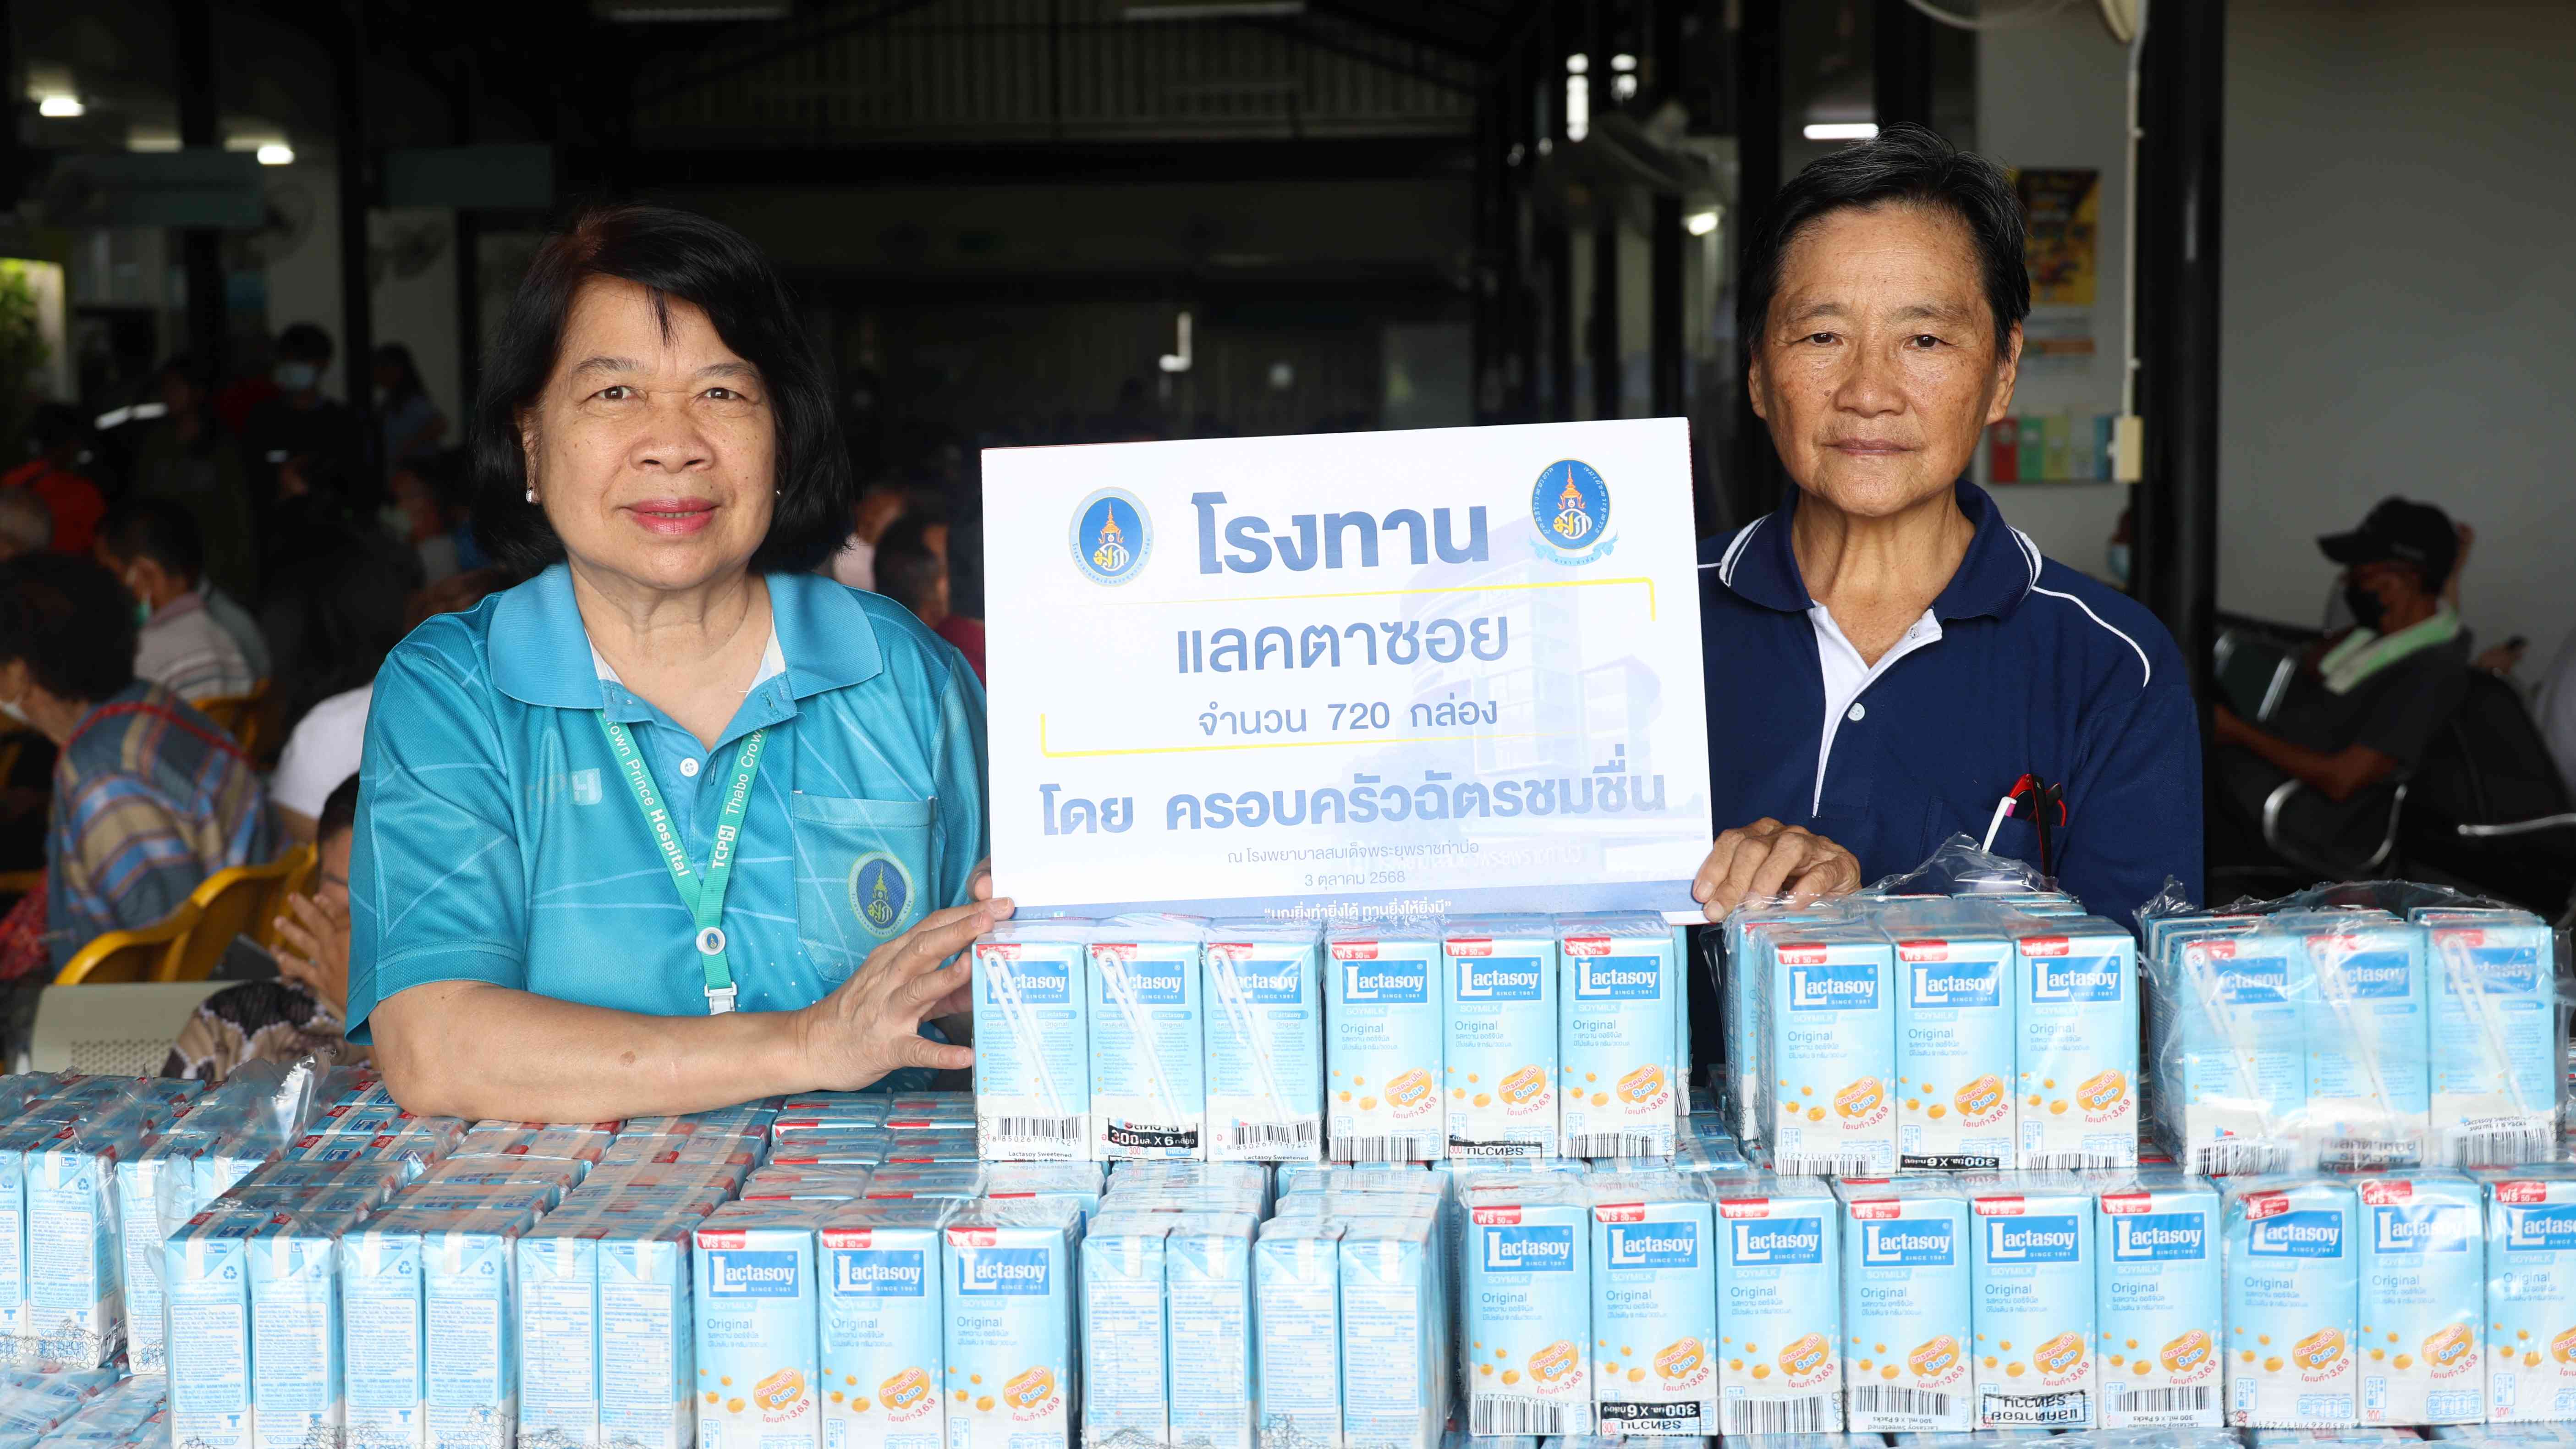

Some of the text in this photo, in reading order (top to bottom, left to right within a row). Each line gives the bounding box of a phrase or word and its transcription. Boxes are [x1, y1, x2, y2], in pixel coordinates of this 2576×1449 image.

[1190, 491, 1488, 574] โรงทาน
[1177, 616, 1508, 674] แลคตาซอย
[1198, 693, 1497, 735] จำนวน 720 กล่อง
[725, 773, 749, 815] Thabo
[1039, 744, 1666, 835] โดย ครอบครัวฉัตรชมชื่น
[626, 759, 654, 806] Prince
[650, 808, 690, 877] Hospital
[1228, 852, 1242, 863] ณ
[1247, 840, 1478, 862] โรงพยาบาลสมเด็จพระยุพราชท่าบ่อ
[1305, 871, 1405, 890] 3 ตุลาคม 2568
[1346, 966, 1424, 999] Lactasoy
[1461, 963, 1539, 996] Lactasoy
[1579, 962, 1657, 995] Lactasoy
[1915, 968, 1997, 1003] Lactasoy
[2036, 963, 2118, 997] Lactasoy
[1794, 971, 1876, 1005] Lactasoy
[1341, 1024, 1384, 1035] Original
[1455, 1021, 1498, 1032] Original
[1573, 1020, 1616, 1032] Original
[1909, 1029, 1953, 1041] Original
[1788, 1031, 1833, 1043] Original
[1419, 1096, 1437, 1113] 3,6,9
[1533, 1094, 1551, 1110] 3,6,9
[1651, 1092, 1669, 1109] 3,6,9
[2113, 1099, 2131, 1117] 3,6,9
[1870, 1106, 1889, 1124] 3,6,9
[1990, 1104, 2009, 1122] 3,6,9
[1111, 1129, 1139, 1145] 300
[1154, 1137, 1161, 1145] X
[1164, 1136, 1174, 1146] 6
[1736, 1224, 1819, 1260] Lactasoy
[1991, 1223, 2076, 1258] Lactasoy
[2117, 1220, 2202, 1256] Lactasoy
[2252, 1216, 2340, 1252] Lactasoy
[1488, 1232, 1571, 1267] Lactasoy
[1612, 1229, 1695, 1263] Lactasoy
[1867, 1226, 1951, 1261] Lactasoy
[713, 1257, 796, 1292] Lactasoy
[838, 1256, 922, 1292] Lactasoy
[963, 1254, 1046, 1290] Lactasoy
[1731, 1287, 1776, 1299] Original
[1986, 1284, 2032, 1297] Original
[2112, 1283, 2158, 1295] Original
[2245, 1278, 2293, 1291] Original
[1482, 1293, 1527, 1305] Original
[1606, 1290, 1651, 1302] Original
[1861, 1288, 1906, 1300] Original
[707, 1319, 752, 1331] Original
[832, 1318, 877, 1331] Original
[957, 1317, 1002, 1329] Original
[2071, 1362, 2090, 1380] 3,6,9
[2198, 1360, 2217, 1378] 3,6,9
[2330, 1359, 2350, 1377] 3,6,9
[2459, 1354, 2478, 1372] 3,6,9
[1565, 1371, 1584, 1389] 3,6,9
[1691, 1367, 1710, 1386] 3,6,9
[1816, 1363, 1835, 1382] 3,6,9
[1945, 1366, 1965, 1383] 3,6,9
[791, 1399, 810, 1418] 3,6,9
[916, 1398, 935, 1416] 3,6,9
[1040, 1397, 1060, 1416] 3,6,9
